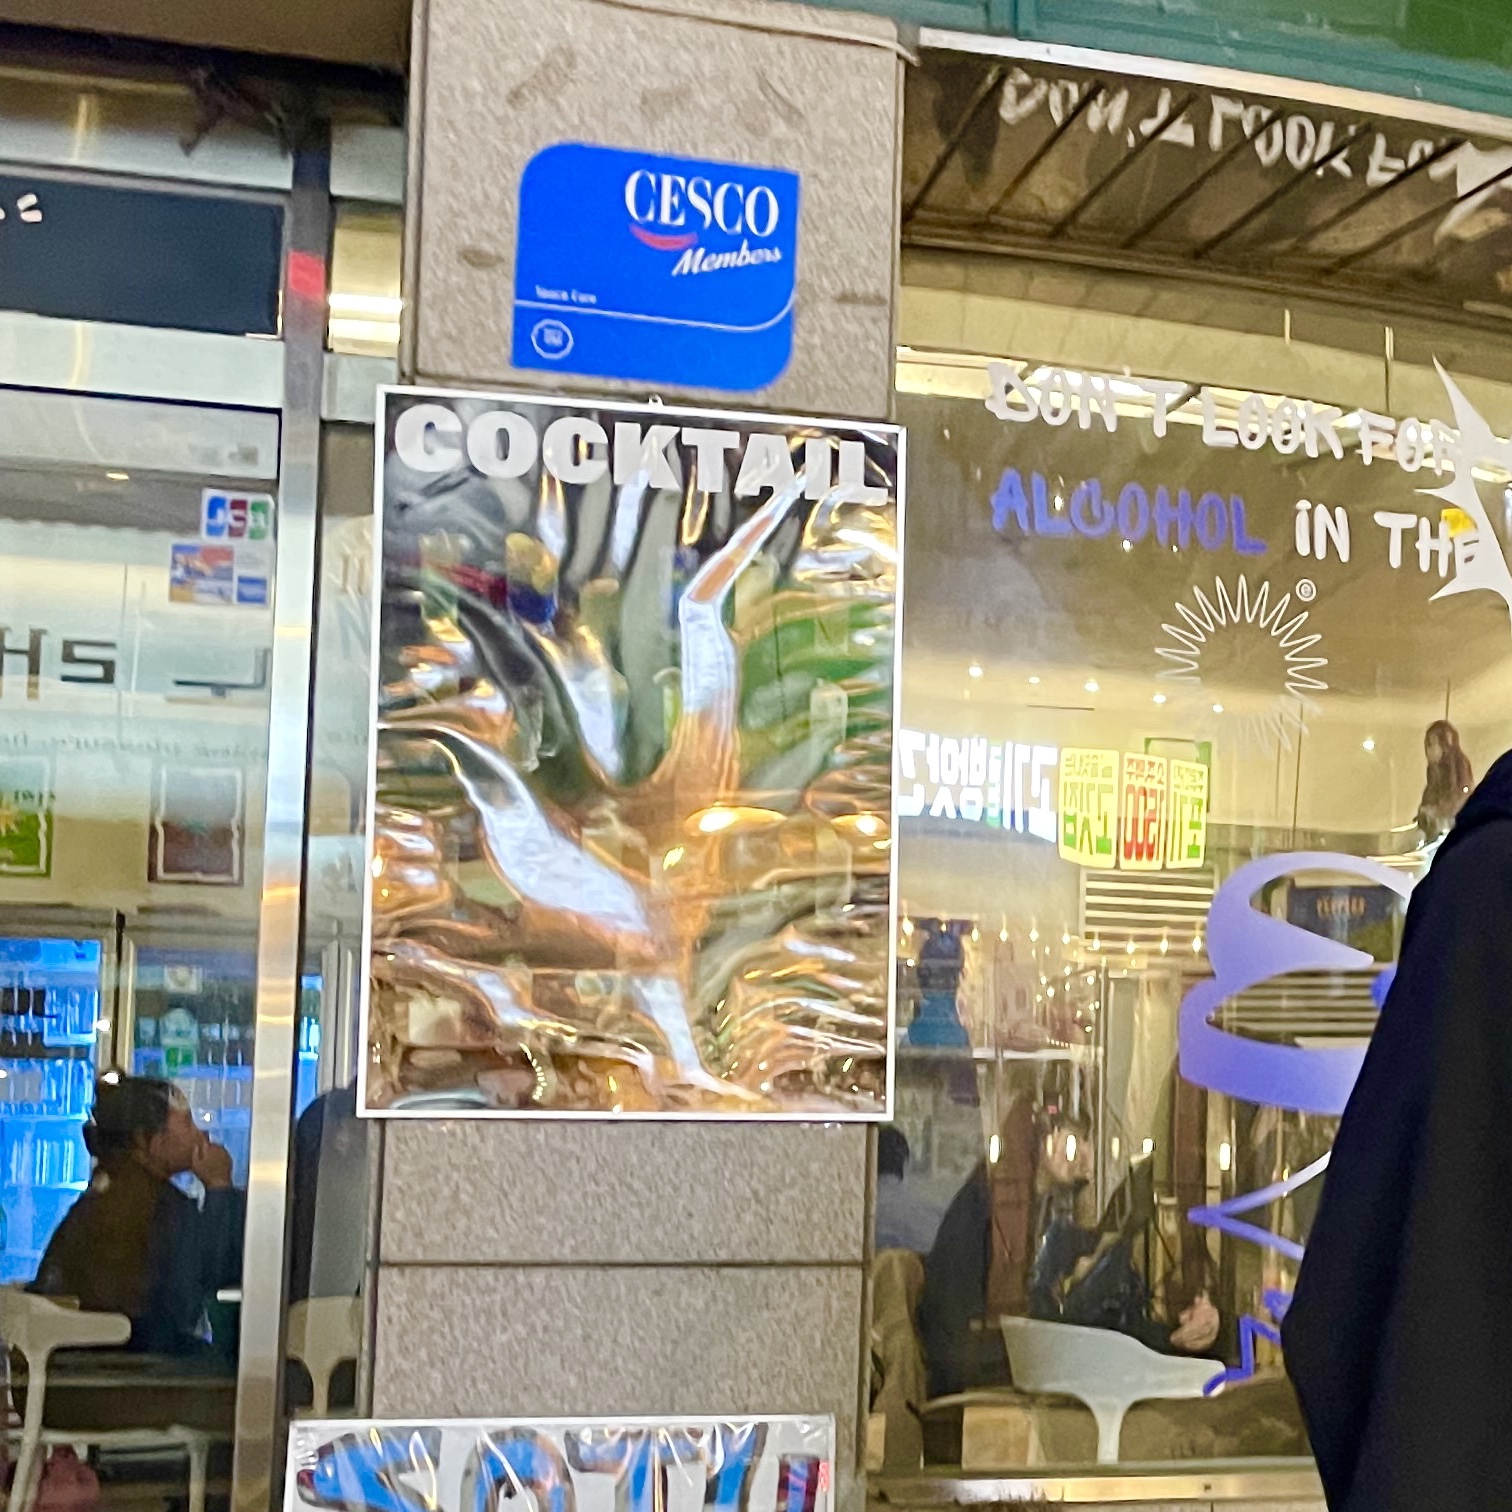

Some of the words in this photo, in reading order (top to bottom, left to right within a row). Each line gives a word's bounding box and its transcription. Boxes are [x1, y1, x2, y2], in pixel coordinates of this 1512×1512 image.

[623, 168, 780, 238] CESCO
[671, 238, 783, 277] Members
[394, 402, 892, 504] COCKTAIL
[1201, 386, 1344, 460] LOOK
[990, 466, 1268, 556] ALCOHOL
